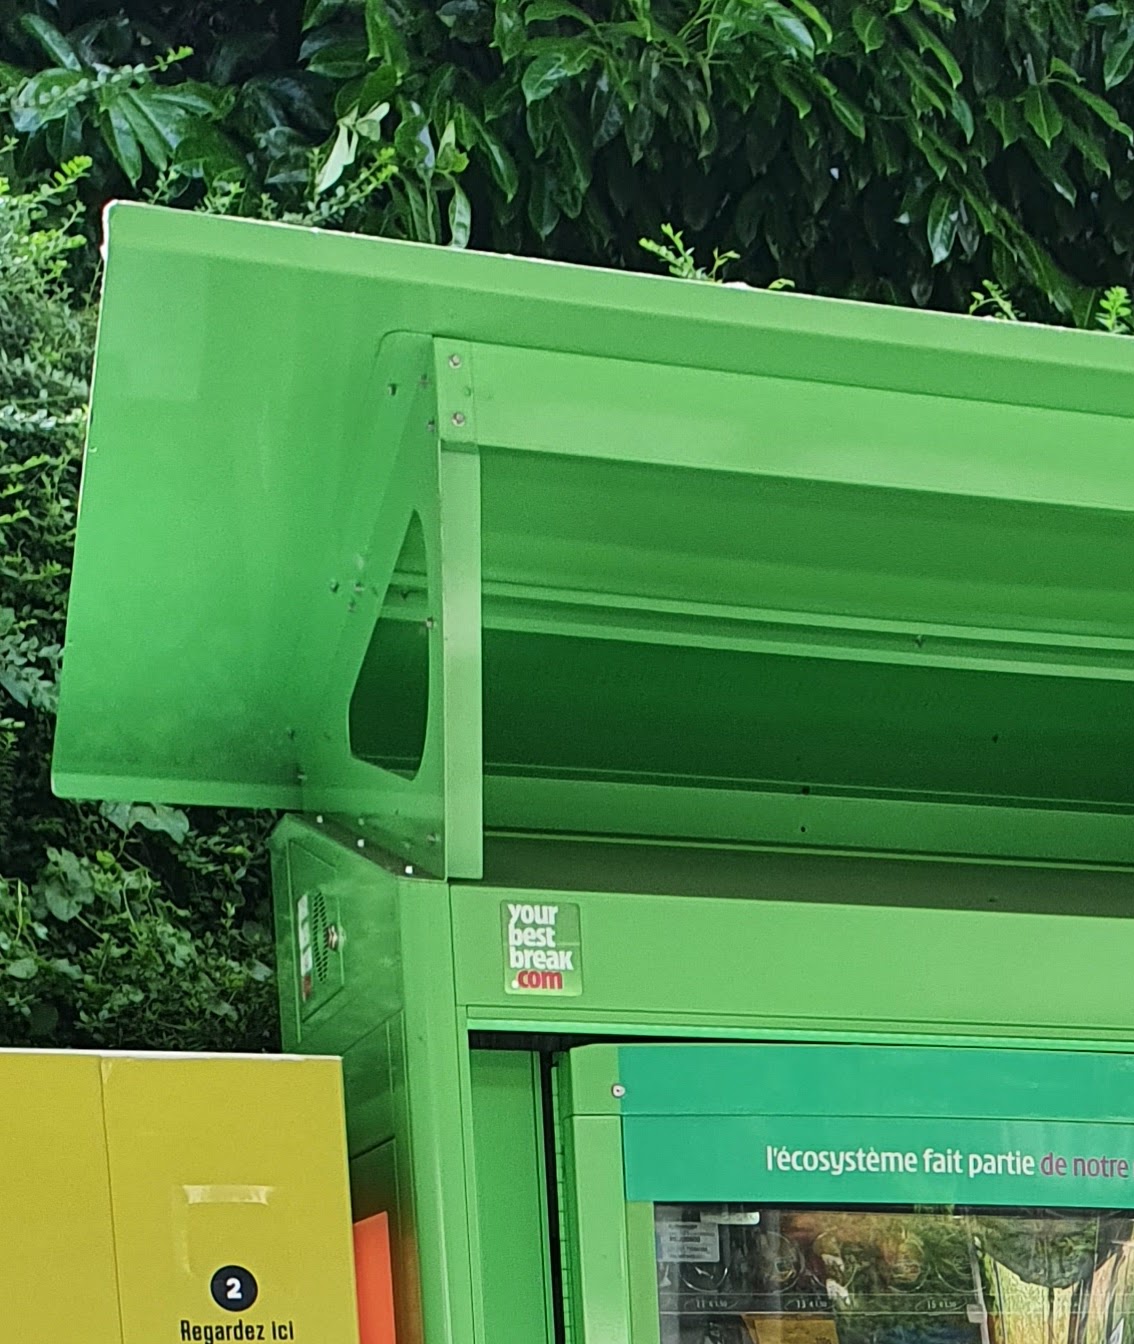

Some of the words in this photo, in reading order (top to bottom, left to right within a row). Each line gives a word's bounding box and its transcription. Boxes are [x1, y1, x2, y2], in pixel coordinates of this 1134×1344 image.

[507, 903, 558, 926] your
[508, 923, 556, 947] best
[509, 948, 574, 971] break
[511, 970, 564, 990] .com
[766, 1145, 918, 1176] l'écosystème
[922, 1147, 963, 1175] fait
[968, 1149, 1035, 1178] partie
[1040, 1153, 1068, 1178] de
[1072, 1154, 1129, 1180] notre
[225, 1278, 242, 1299] 2
[271, 1320, 294, 1340] ici
